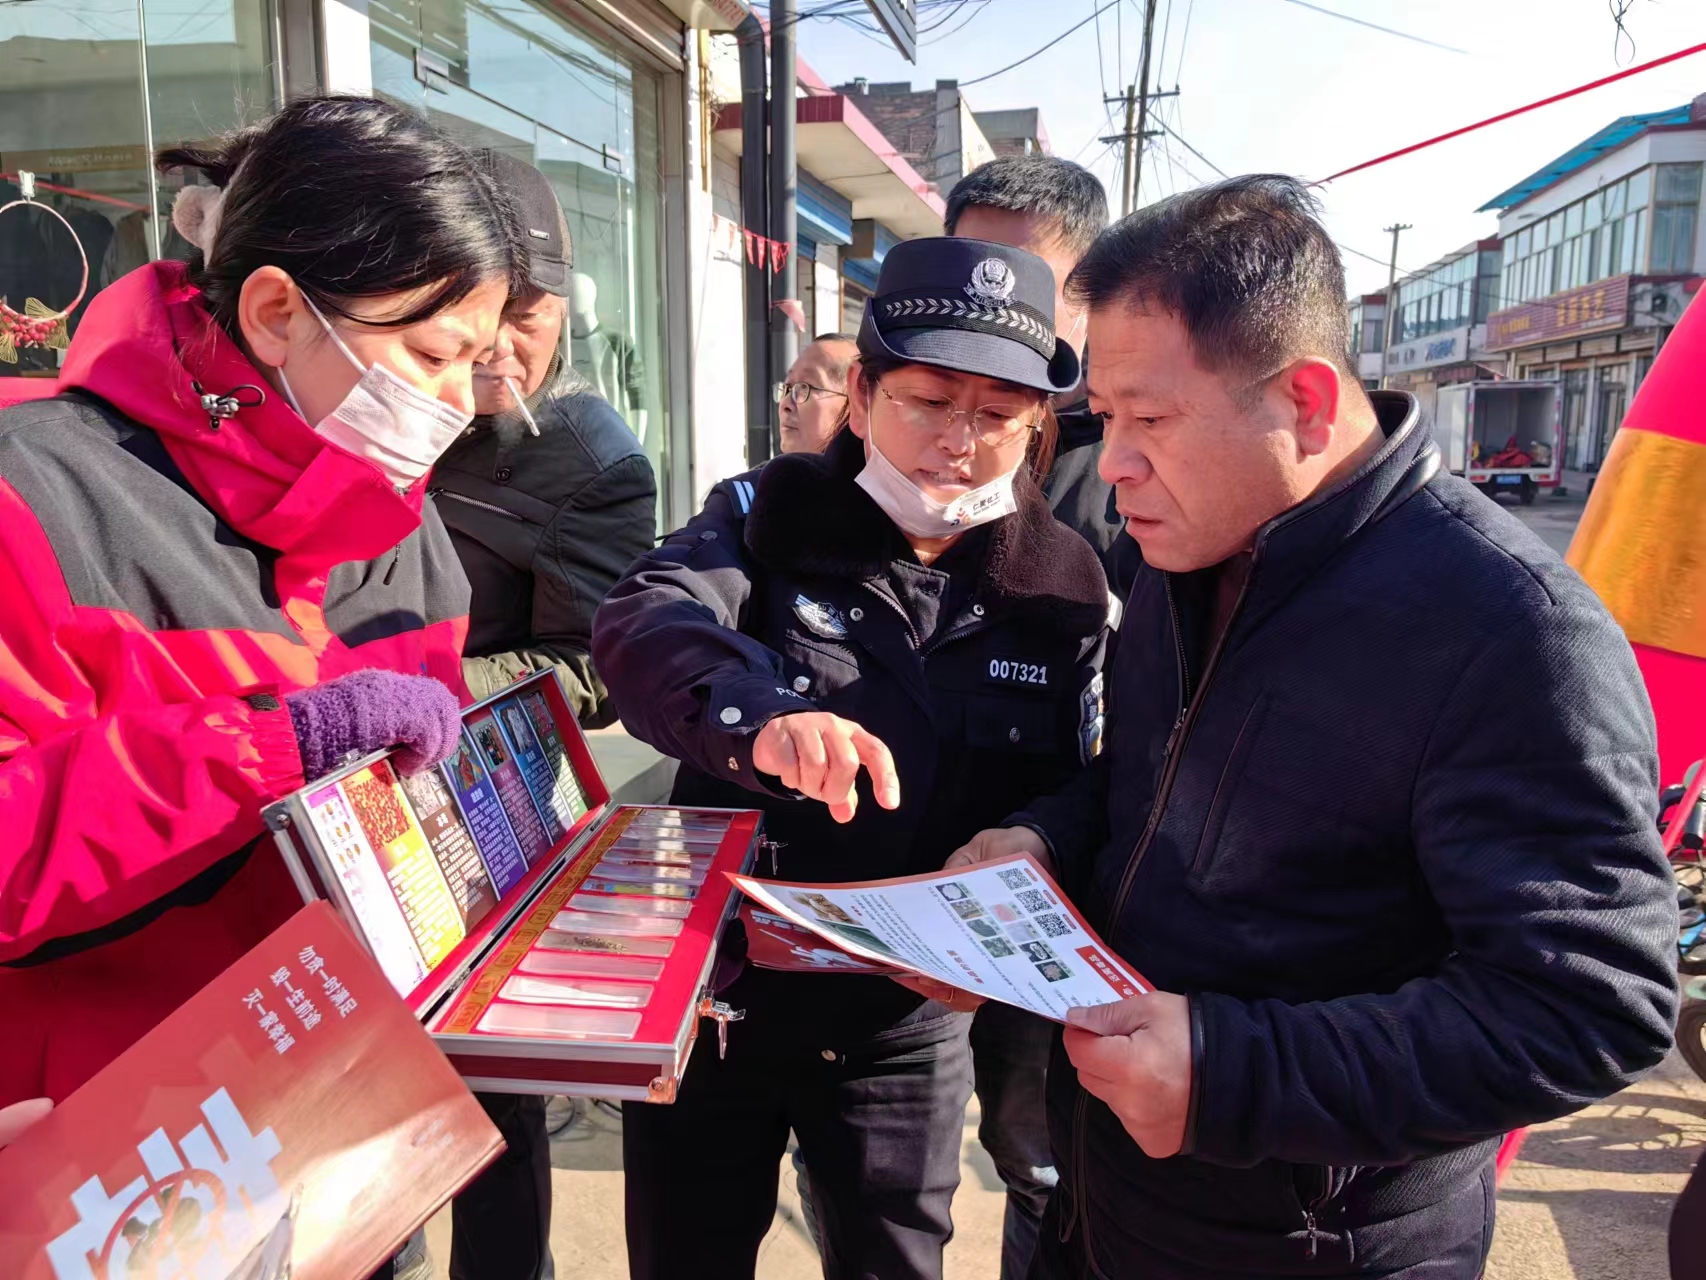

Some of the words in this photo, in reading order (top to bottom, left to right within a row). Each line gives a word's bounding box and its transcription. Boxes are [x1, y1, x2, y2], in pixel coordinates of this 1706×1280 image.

[989, 659, 1048, 685] 007321
[298, 944, 359, 1019] 勿贪一时满足
[241, 988, 296, 1055] 灭一家幸福
